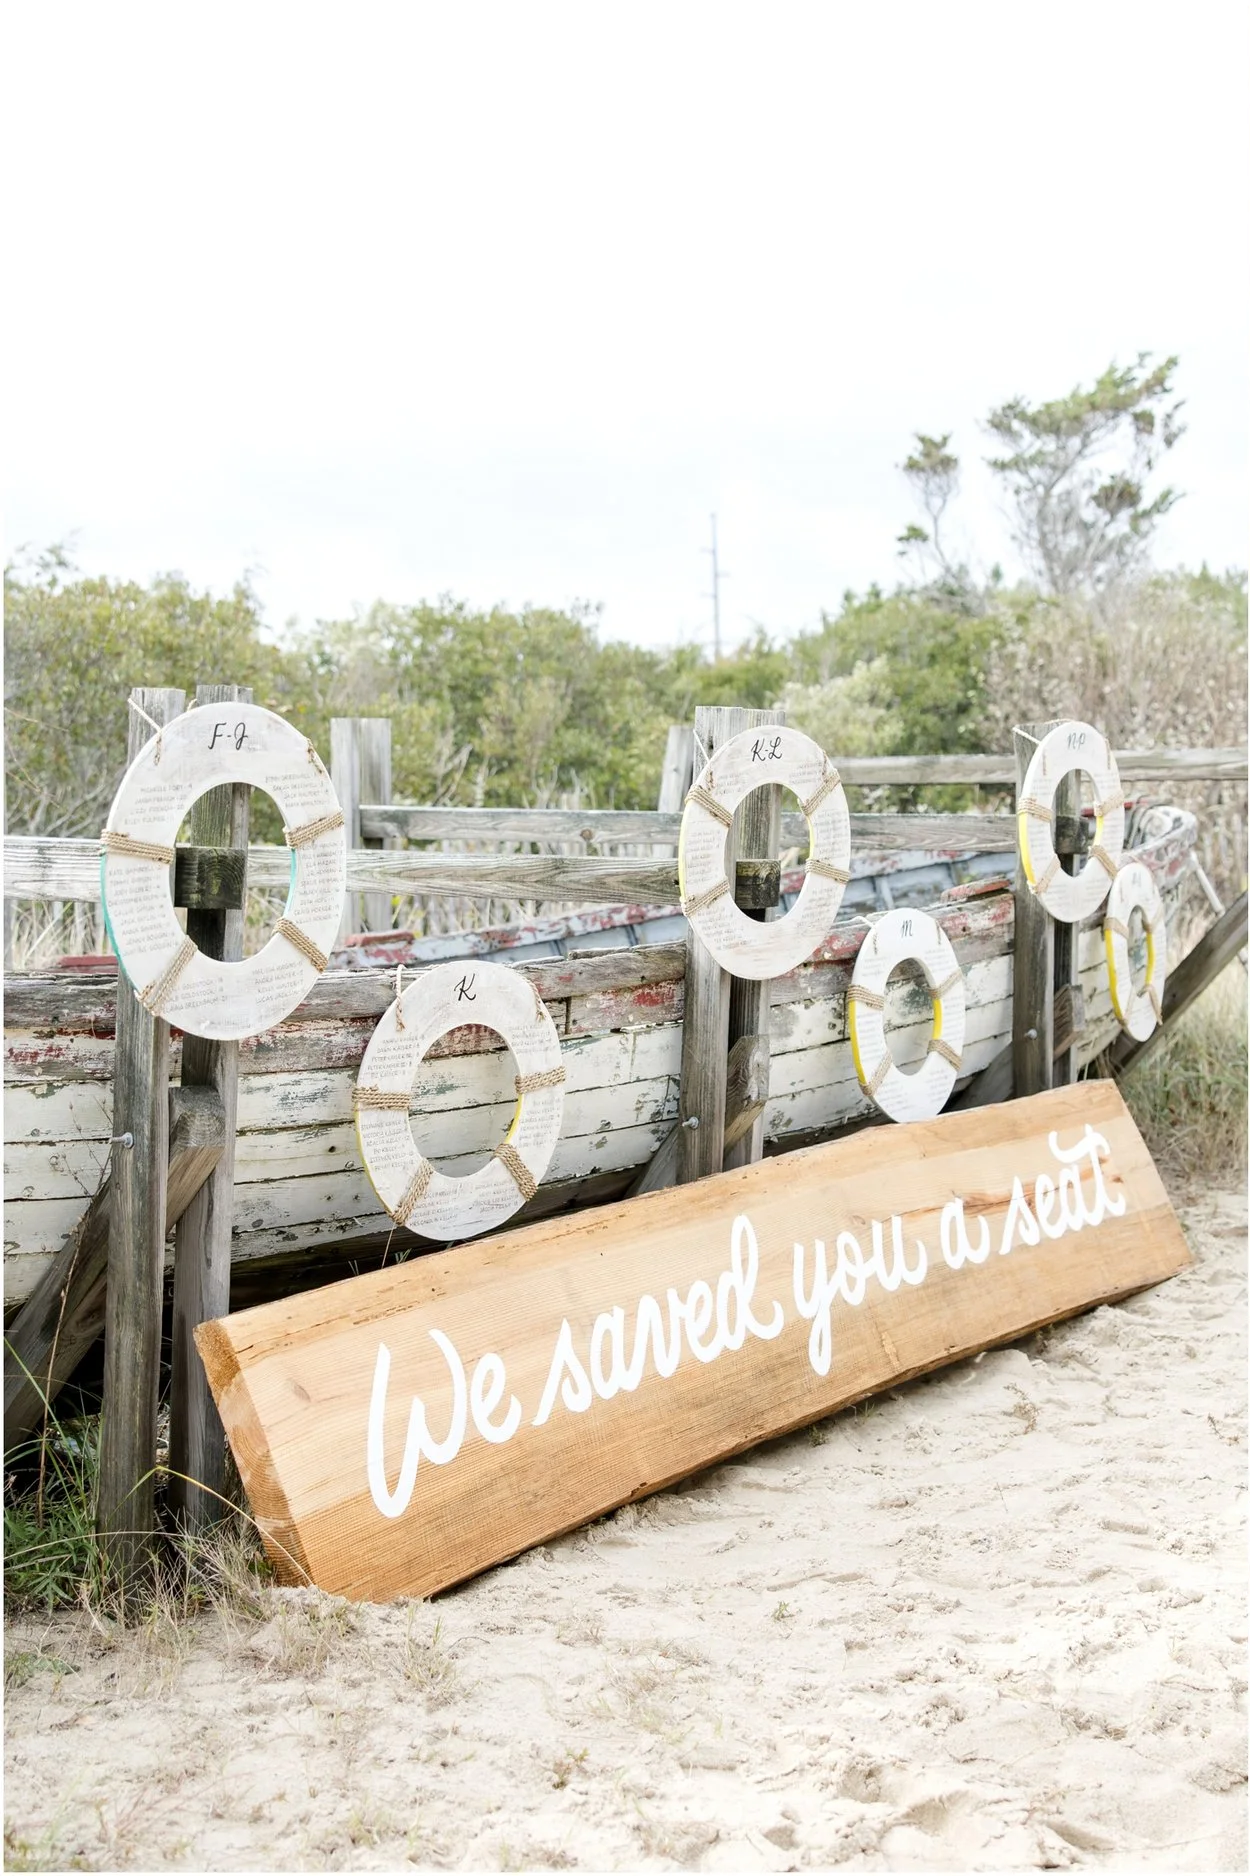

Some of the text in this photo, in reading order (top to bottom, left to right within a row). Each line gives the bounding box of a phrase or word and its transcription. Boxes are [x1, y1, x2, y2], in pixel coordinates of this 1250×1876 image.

[453, 972, 477, 1001] K
[366, 1124, 1127, 1519] We saved you a seat
